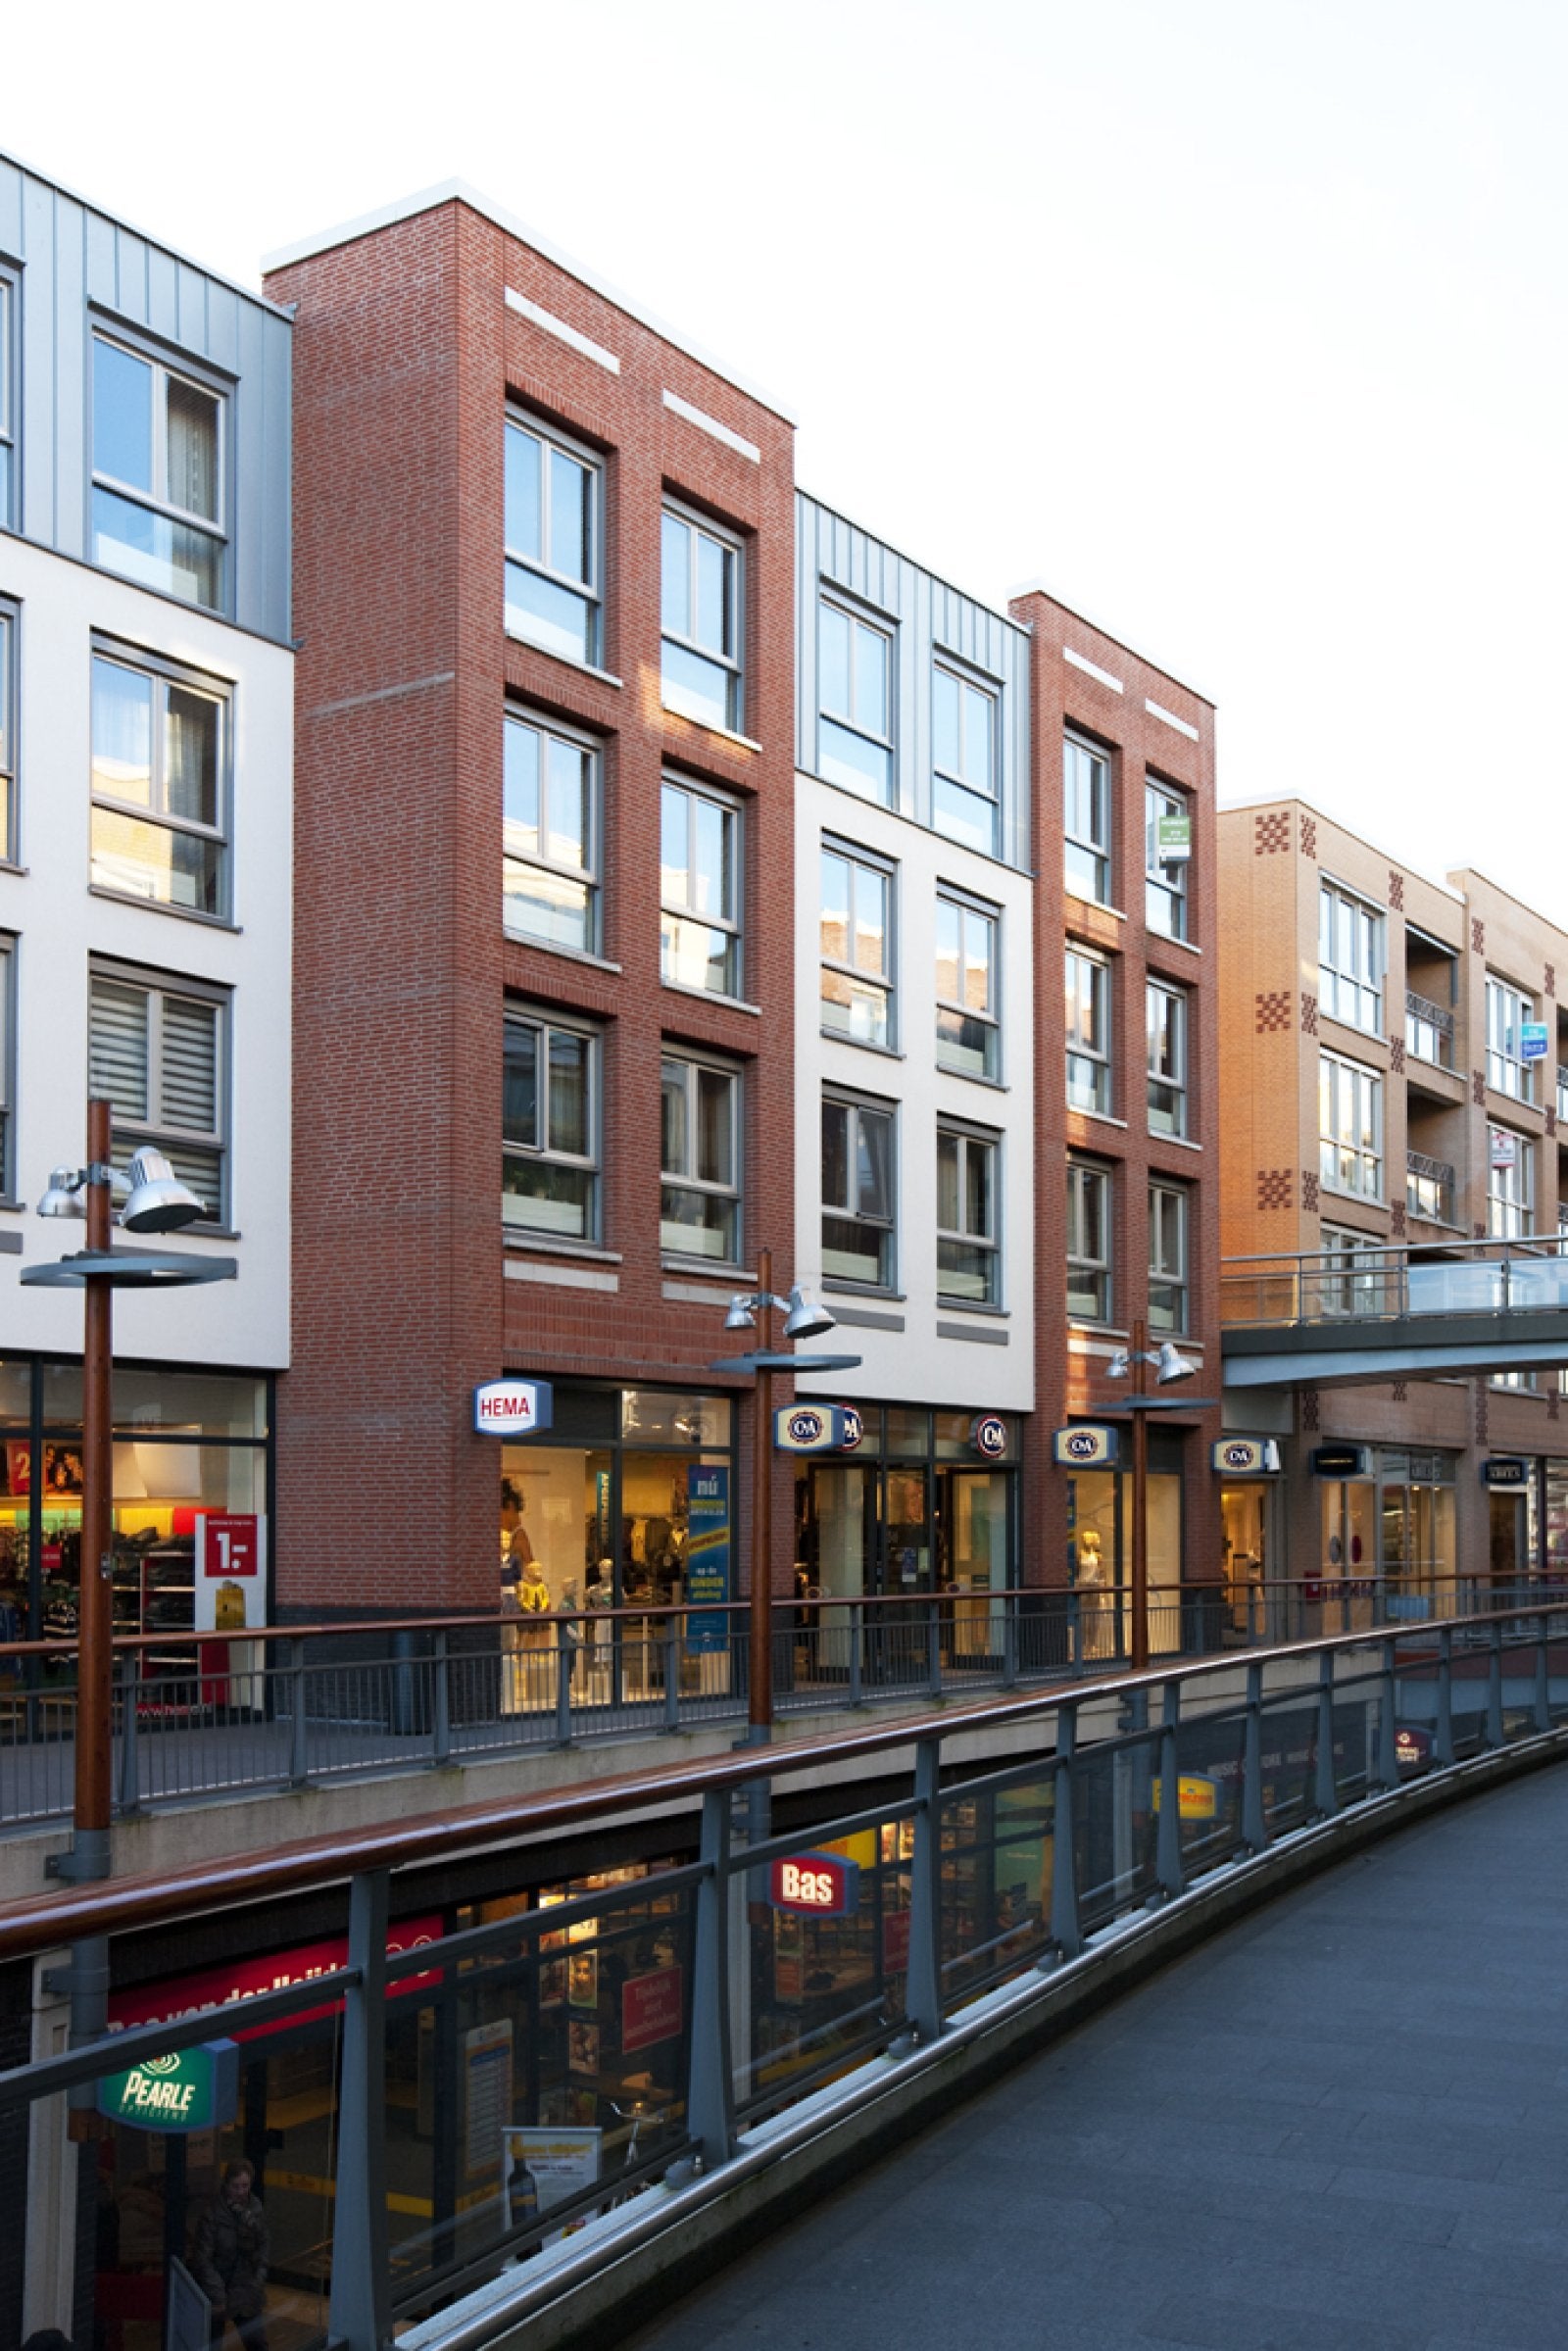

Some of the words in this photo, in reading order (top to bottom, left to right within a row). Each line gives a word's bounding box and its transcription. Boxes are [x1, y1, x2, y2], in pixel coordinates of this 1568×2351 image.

[481, 1397, 530, 1417] HEMA
[782, 1864, 833, 1904] Bas
[122, 2070, 196, 2111] PEARLE
